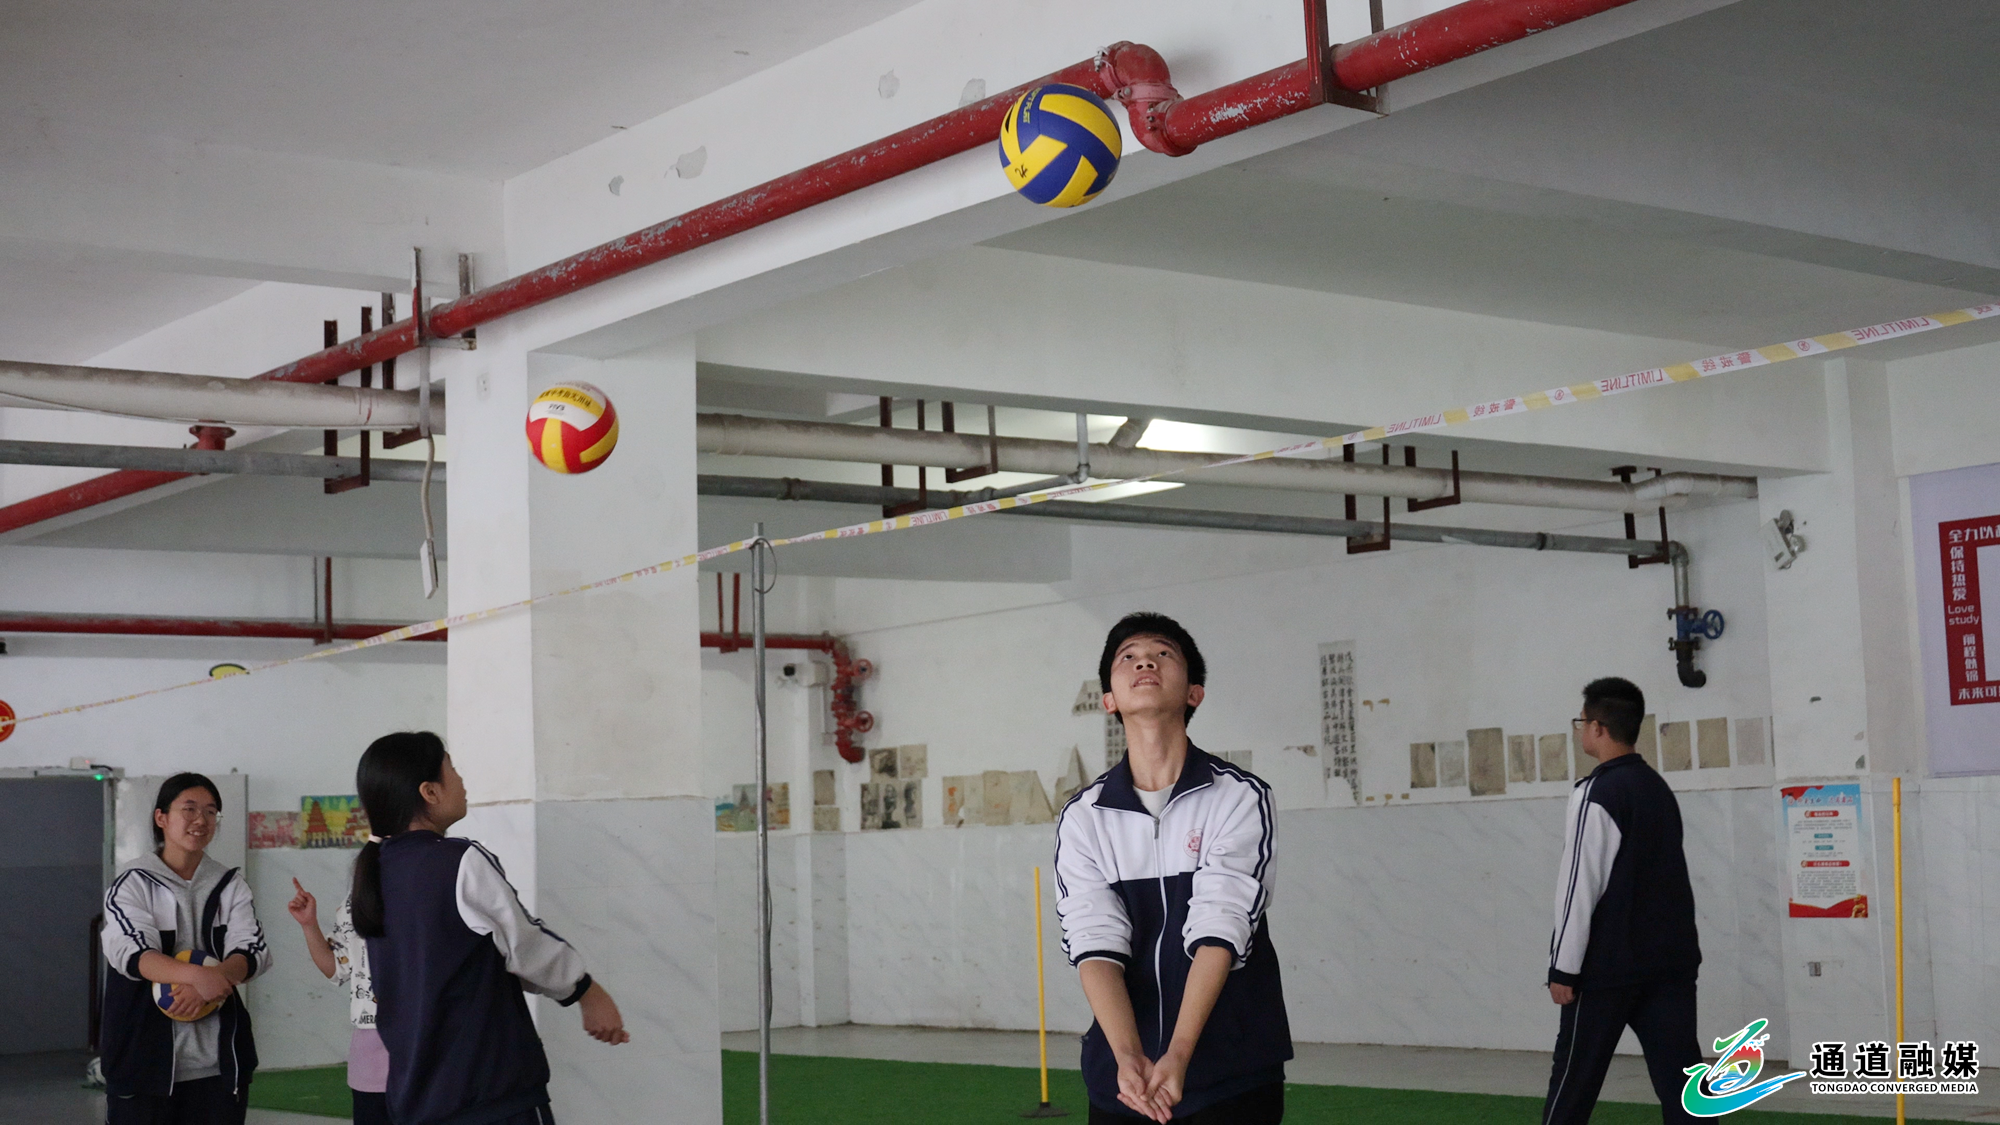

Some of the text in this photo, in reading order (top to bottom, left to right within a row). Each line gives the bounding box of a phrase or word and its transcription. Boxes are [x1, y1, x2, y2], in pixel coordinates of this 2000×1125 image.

[1950, 546, 1967, 601] 保持热爱
[1947, 604, 1975, 615] Love
[1949, 614, 1980, 625] study
[1958, 685, 2000, 700] 未来可
